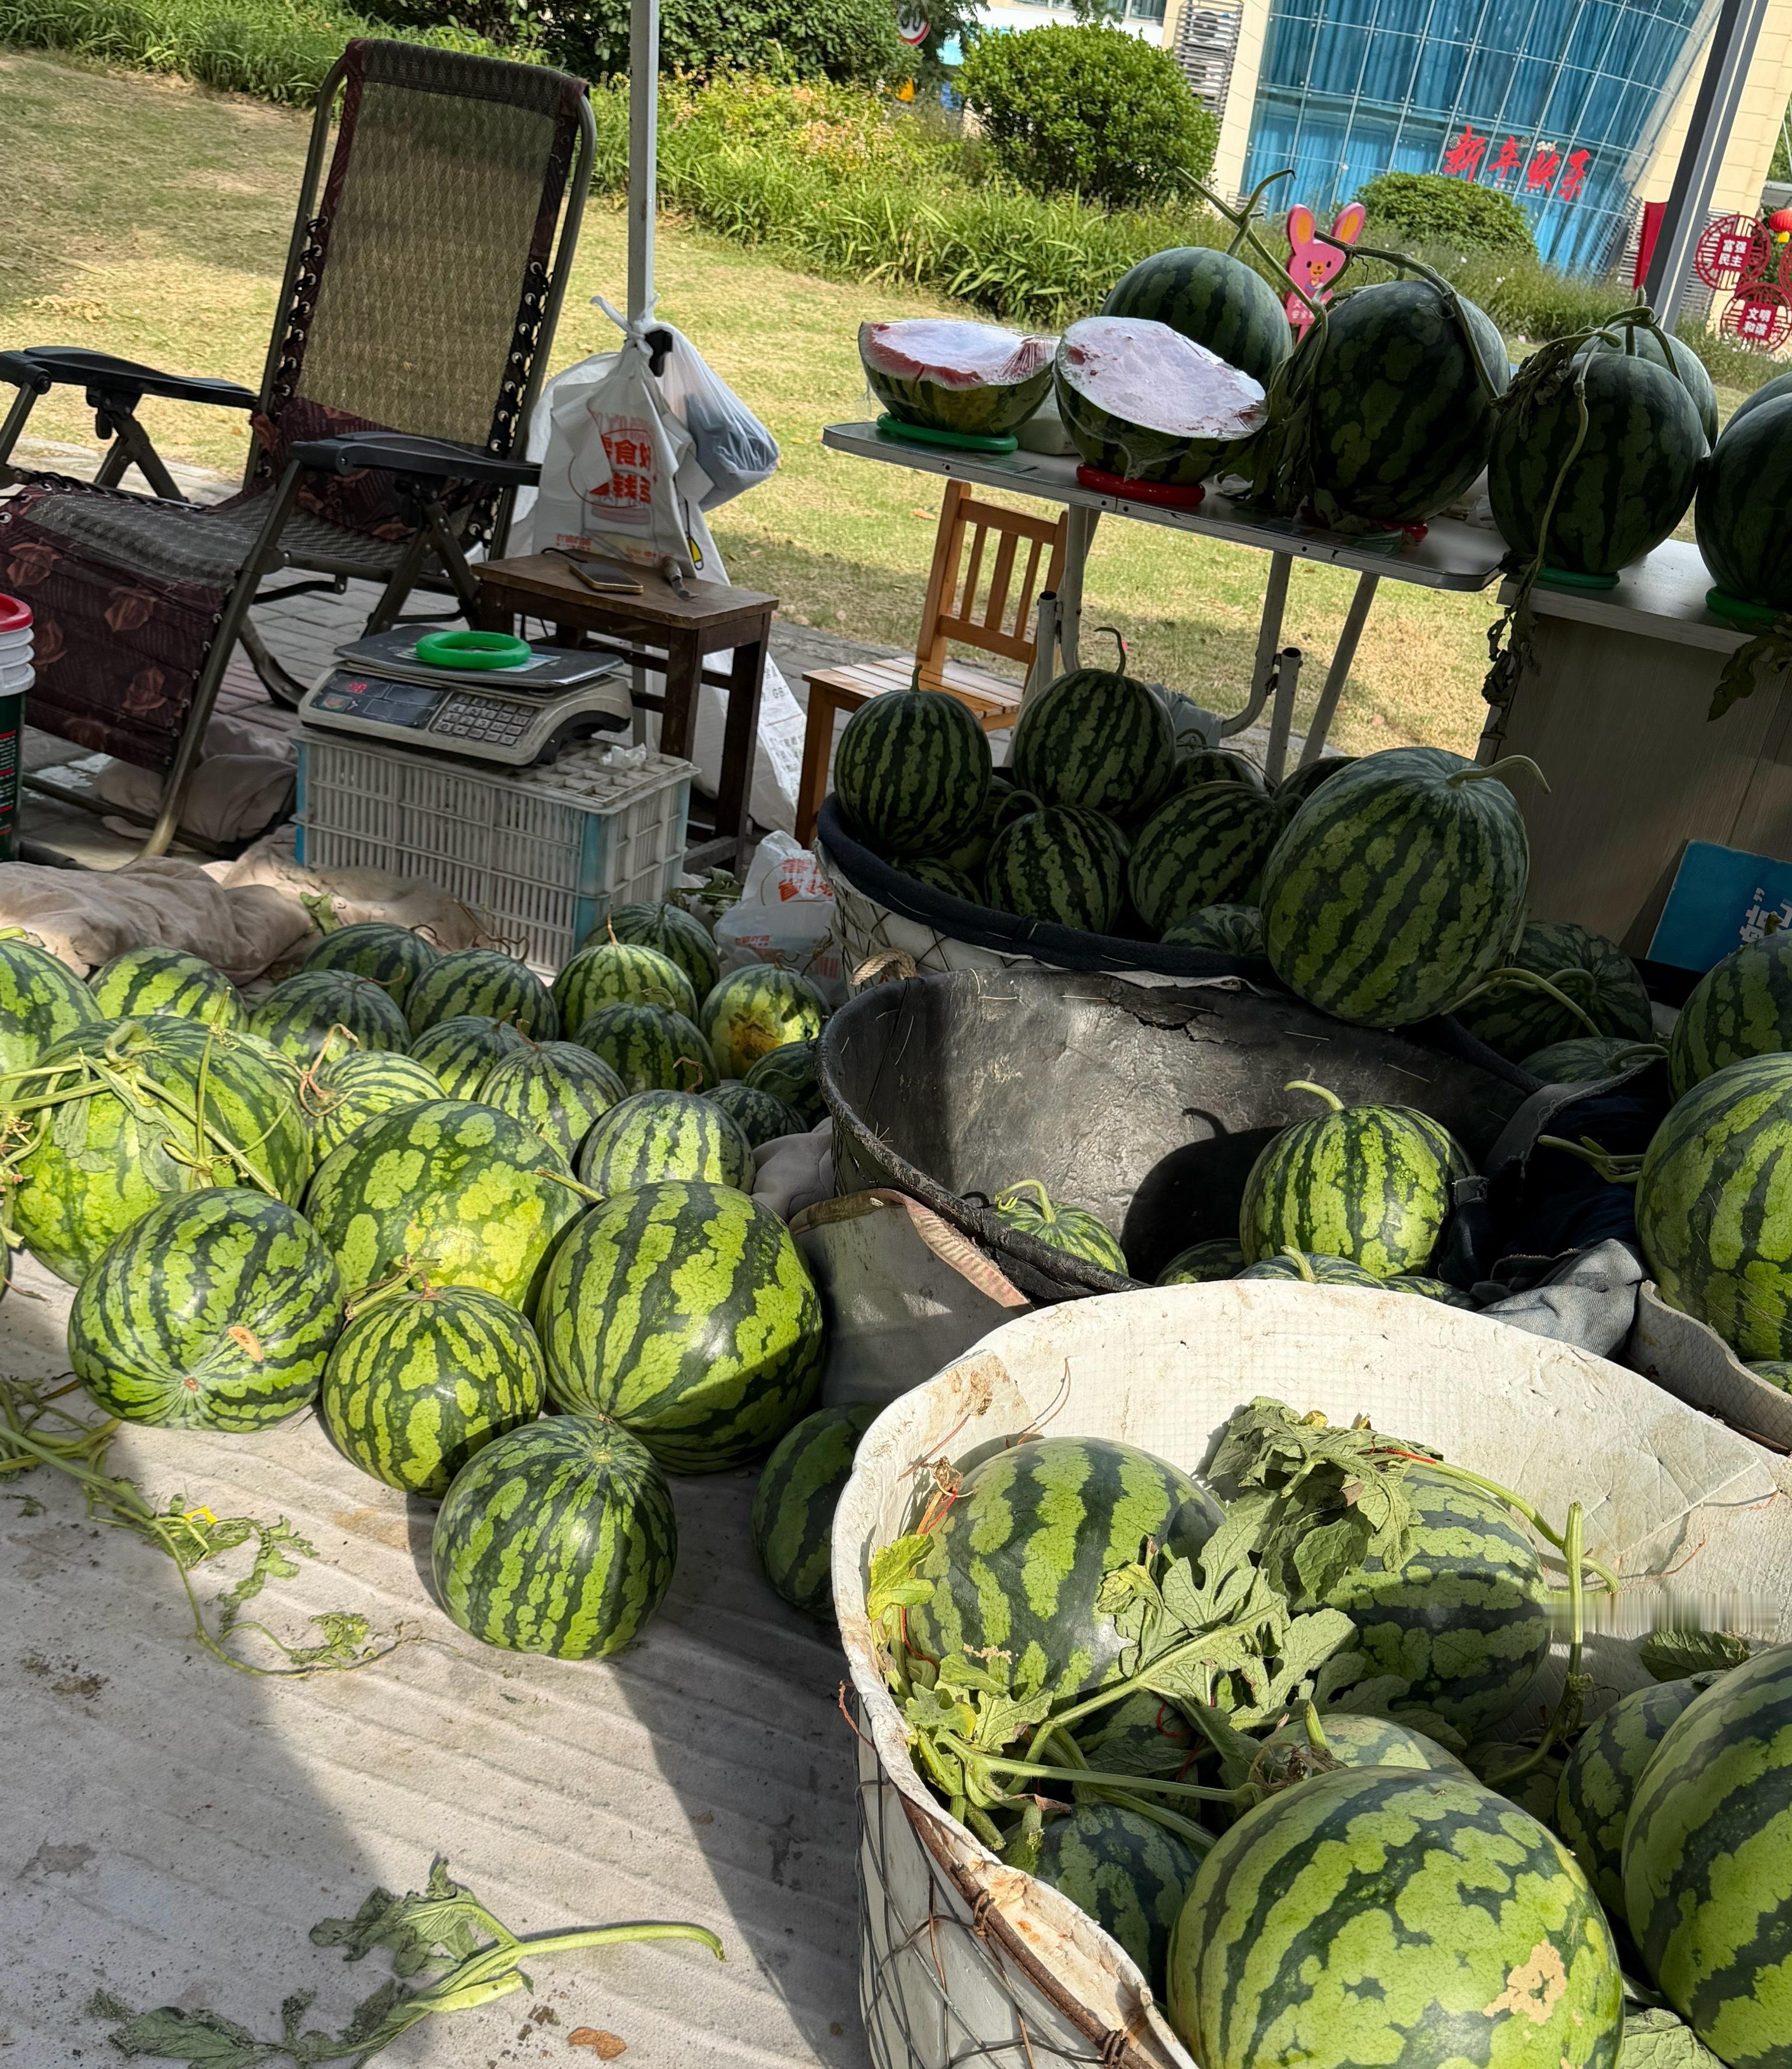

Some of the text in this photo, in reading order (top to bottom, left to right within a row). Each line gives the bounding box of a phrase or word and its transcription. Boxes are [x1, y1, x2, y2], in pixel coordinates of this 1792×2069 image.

[1443, 124, 1591, 202] 新年快乐
[1723, 239, 1747, 254] 富强
[1718, 253, 1742, 268] 民主
[1747, 307, 1772, 322] 文明
[1742, 321, 1768, 337] 和谐
